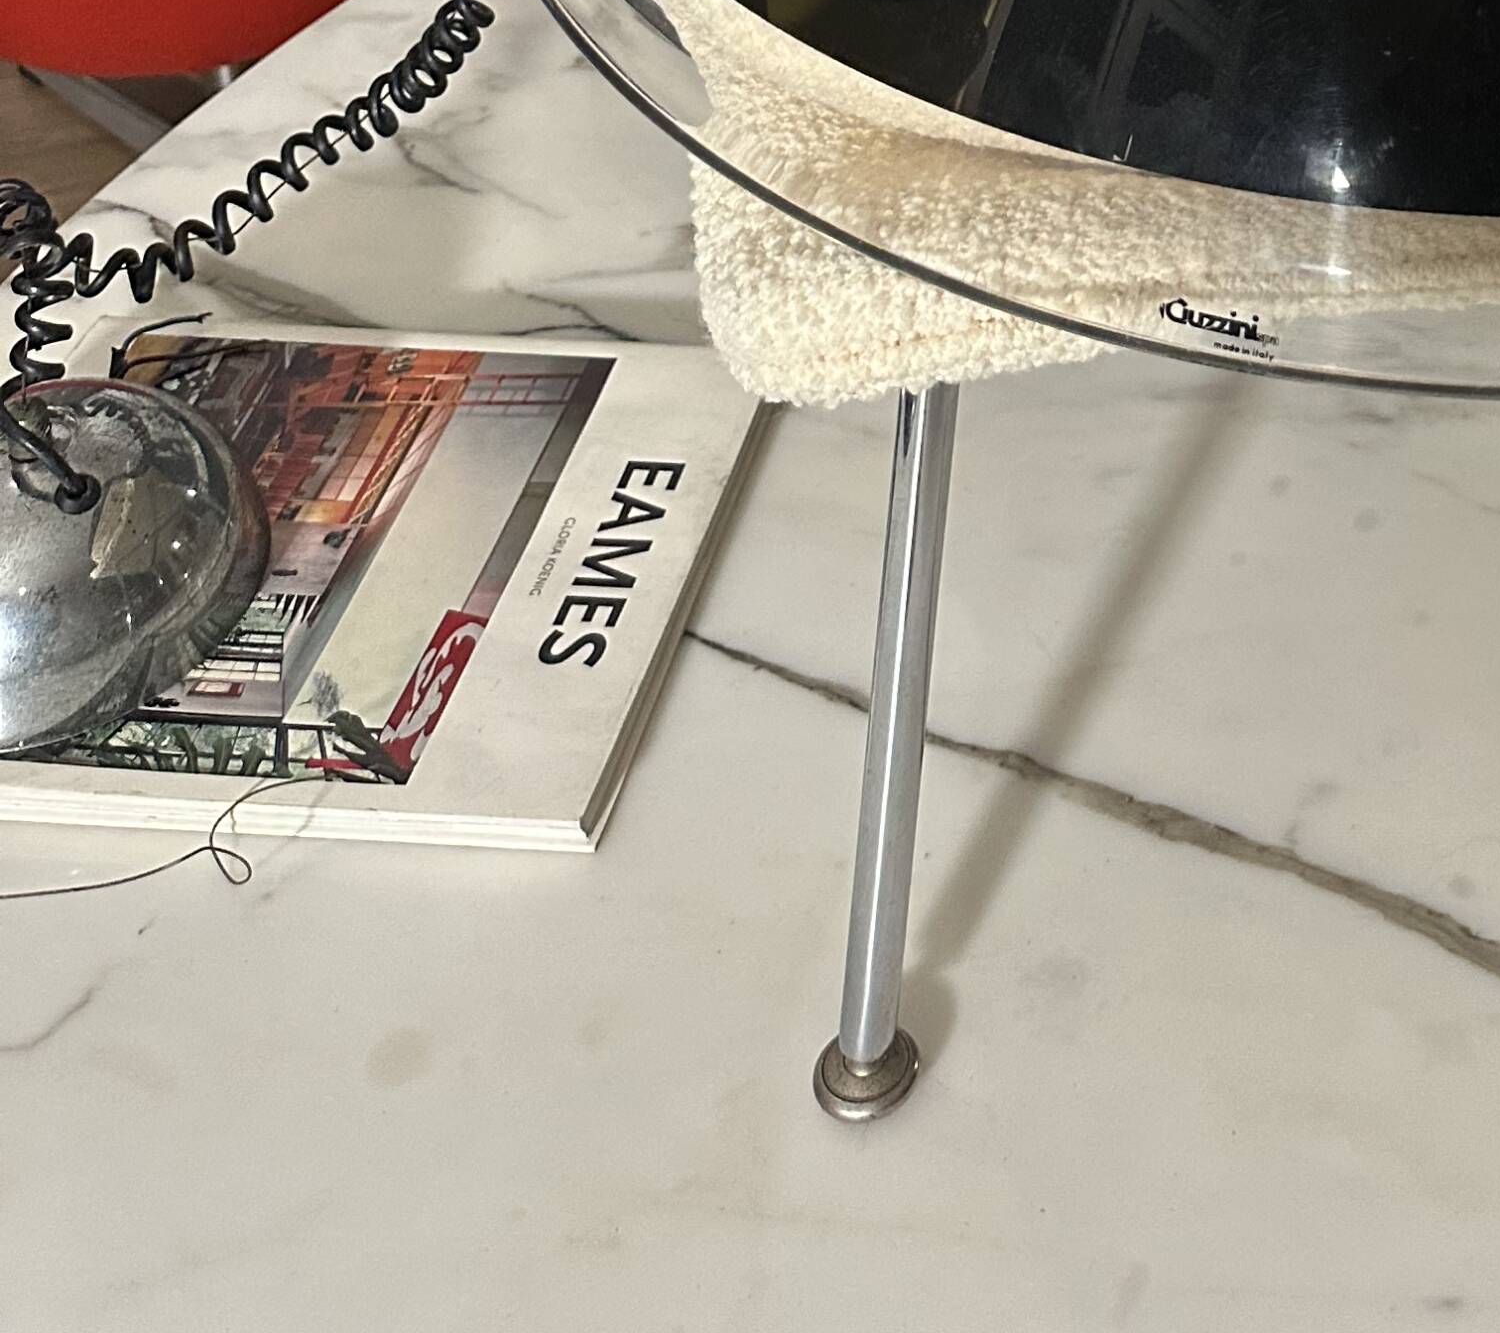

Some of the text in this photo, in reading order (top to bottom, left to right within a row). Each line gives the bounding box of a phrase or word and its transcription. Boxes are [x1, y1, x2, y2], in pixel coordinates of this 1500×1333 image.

[1213, 341, 1240, 353] made
[1241, 347, 1250, 356] in
[529, 517, 577, 596] GLORIA KOENIG
[538, 460, 686, 667] EAMES
